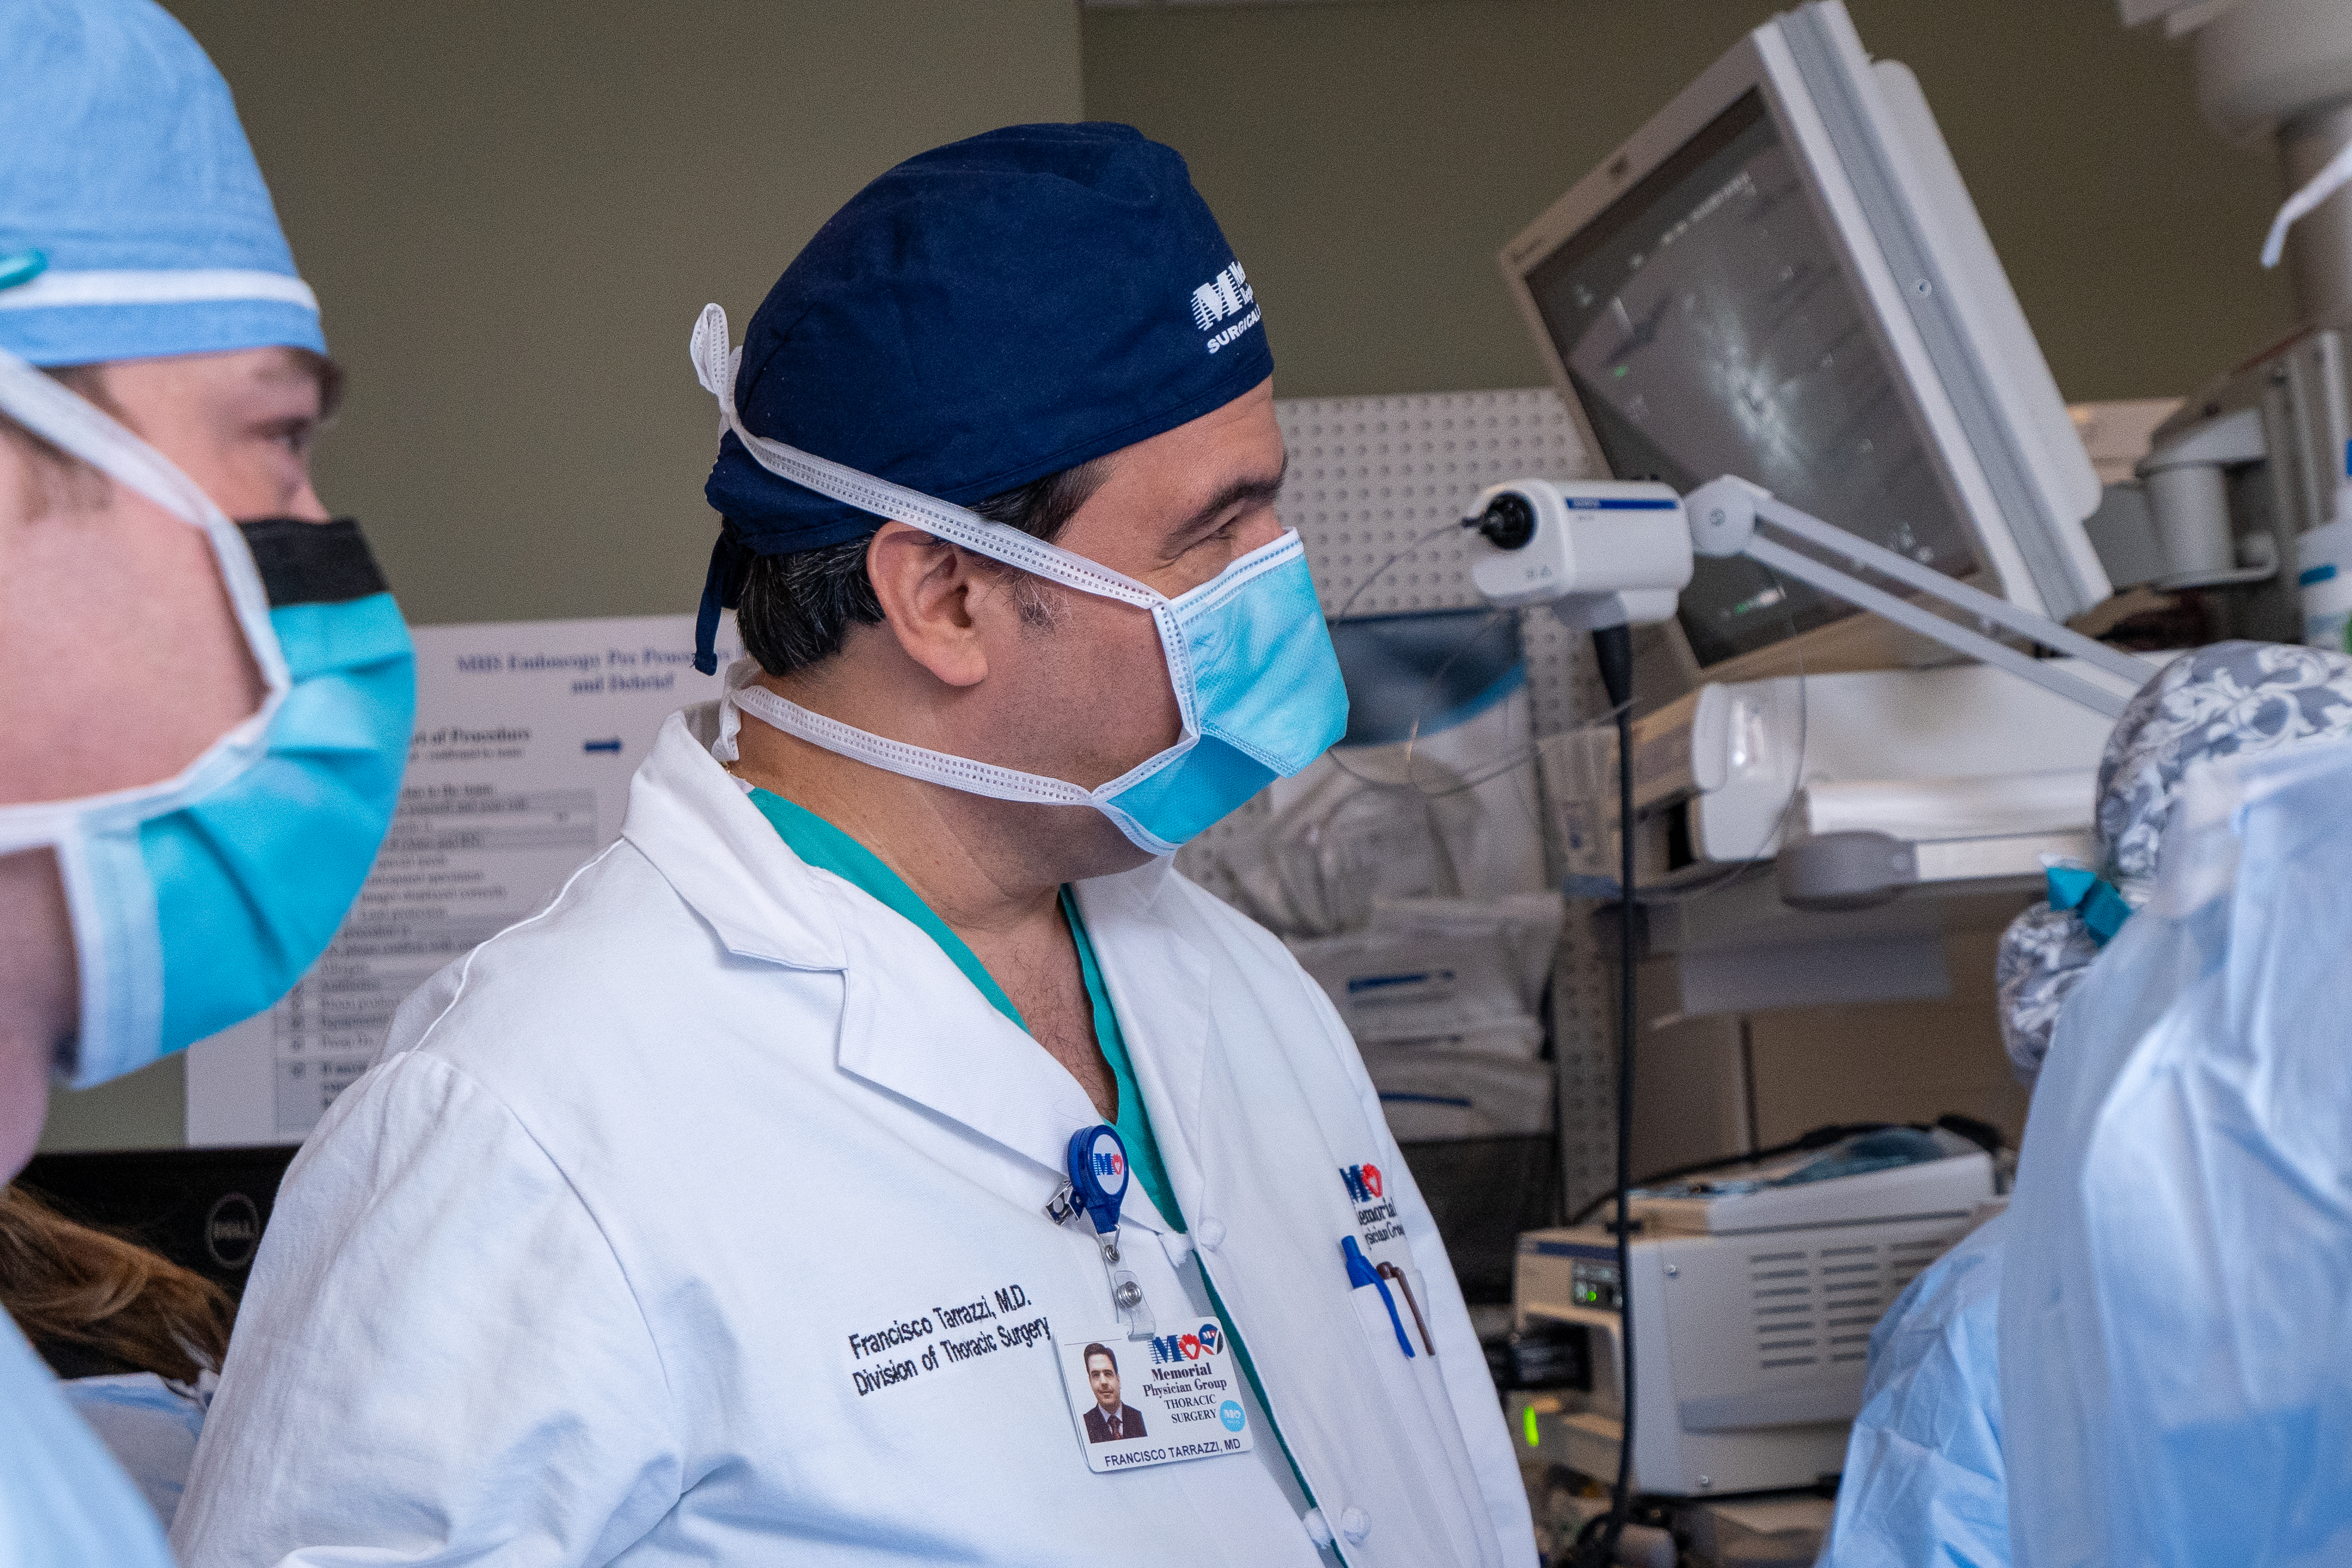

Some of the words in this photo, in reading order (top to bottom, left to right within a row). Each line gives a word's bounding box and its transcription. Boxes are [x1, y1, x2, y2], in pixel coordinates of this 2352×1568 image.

[1358, 1195, 1398, 1226] emorial
[848, 1316, 933, 1359] Francisco
[932, 1295, 997, 1330] Tarrazzi,
[994, 1284, 1032, 1313] M.D.
[852, 1359, 919, 1396] Division
[921, 1345, 939, 1371] of
[939, 1331, 998, 1363] Thoracic
[996, 1316, 1052, 1348] Surgery
[1151, 1362, 1212, 1382] Memorial
[1143, 1380, 1193, 1399] Physician
[1194, 1378, 1227, 1391] Group
[1163, 1394, 1217, 1410] THORACIC
[1171, 1408, 1217, 1424] SURGERY
[1104, 1447, 1166, 1467] FRANCISCO
[1168, 1441, 1224, 1460] TARRAZZI,
[1224, 1437, 1241, 1451] MD
